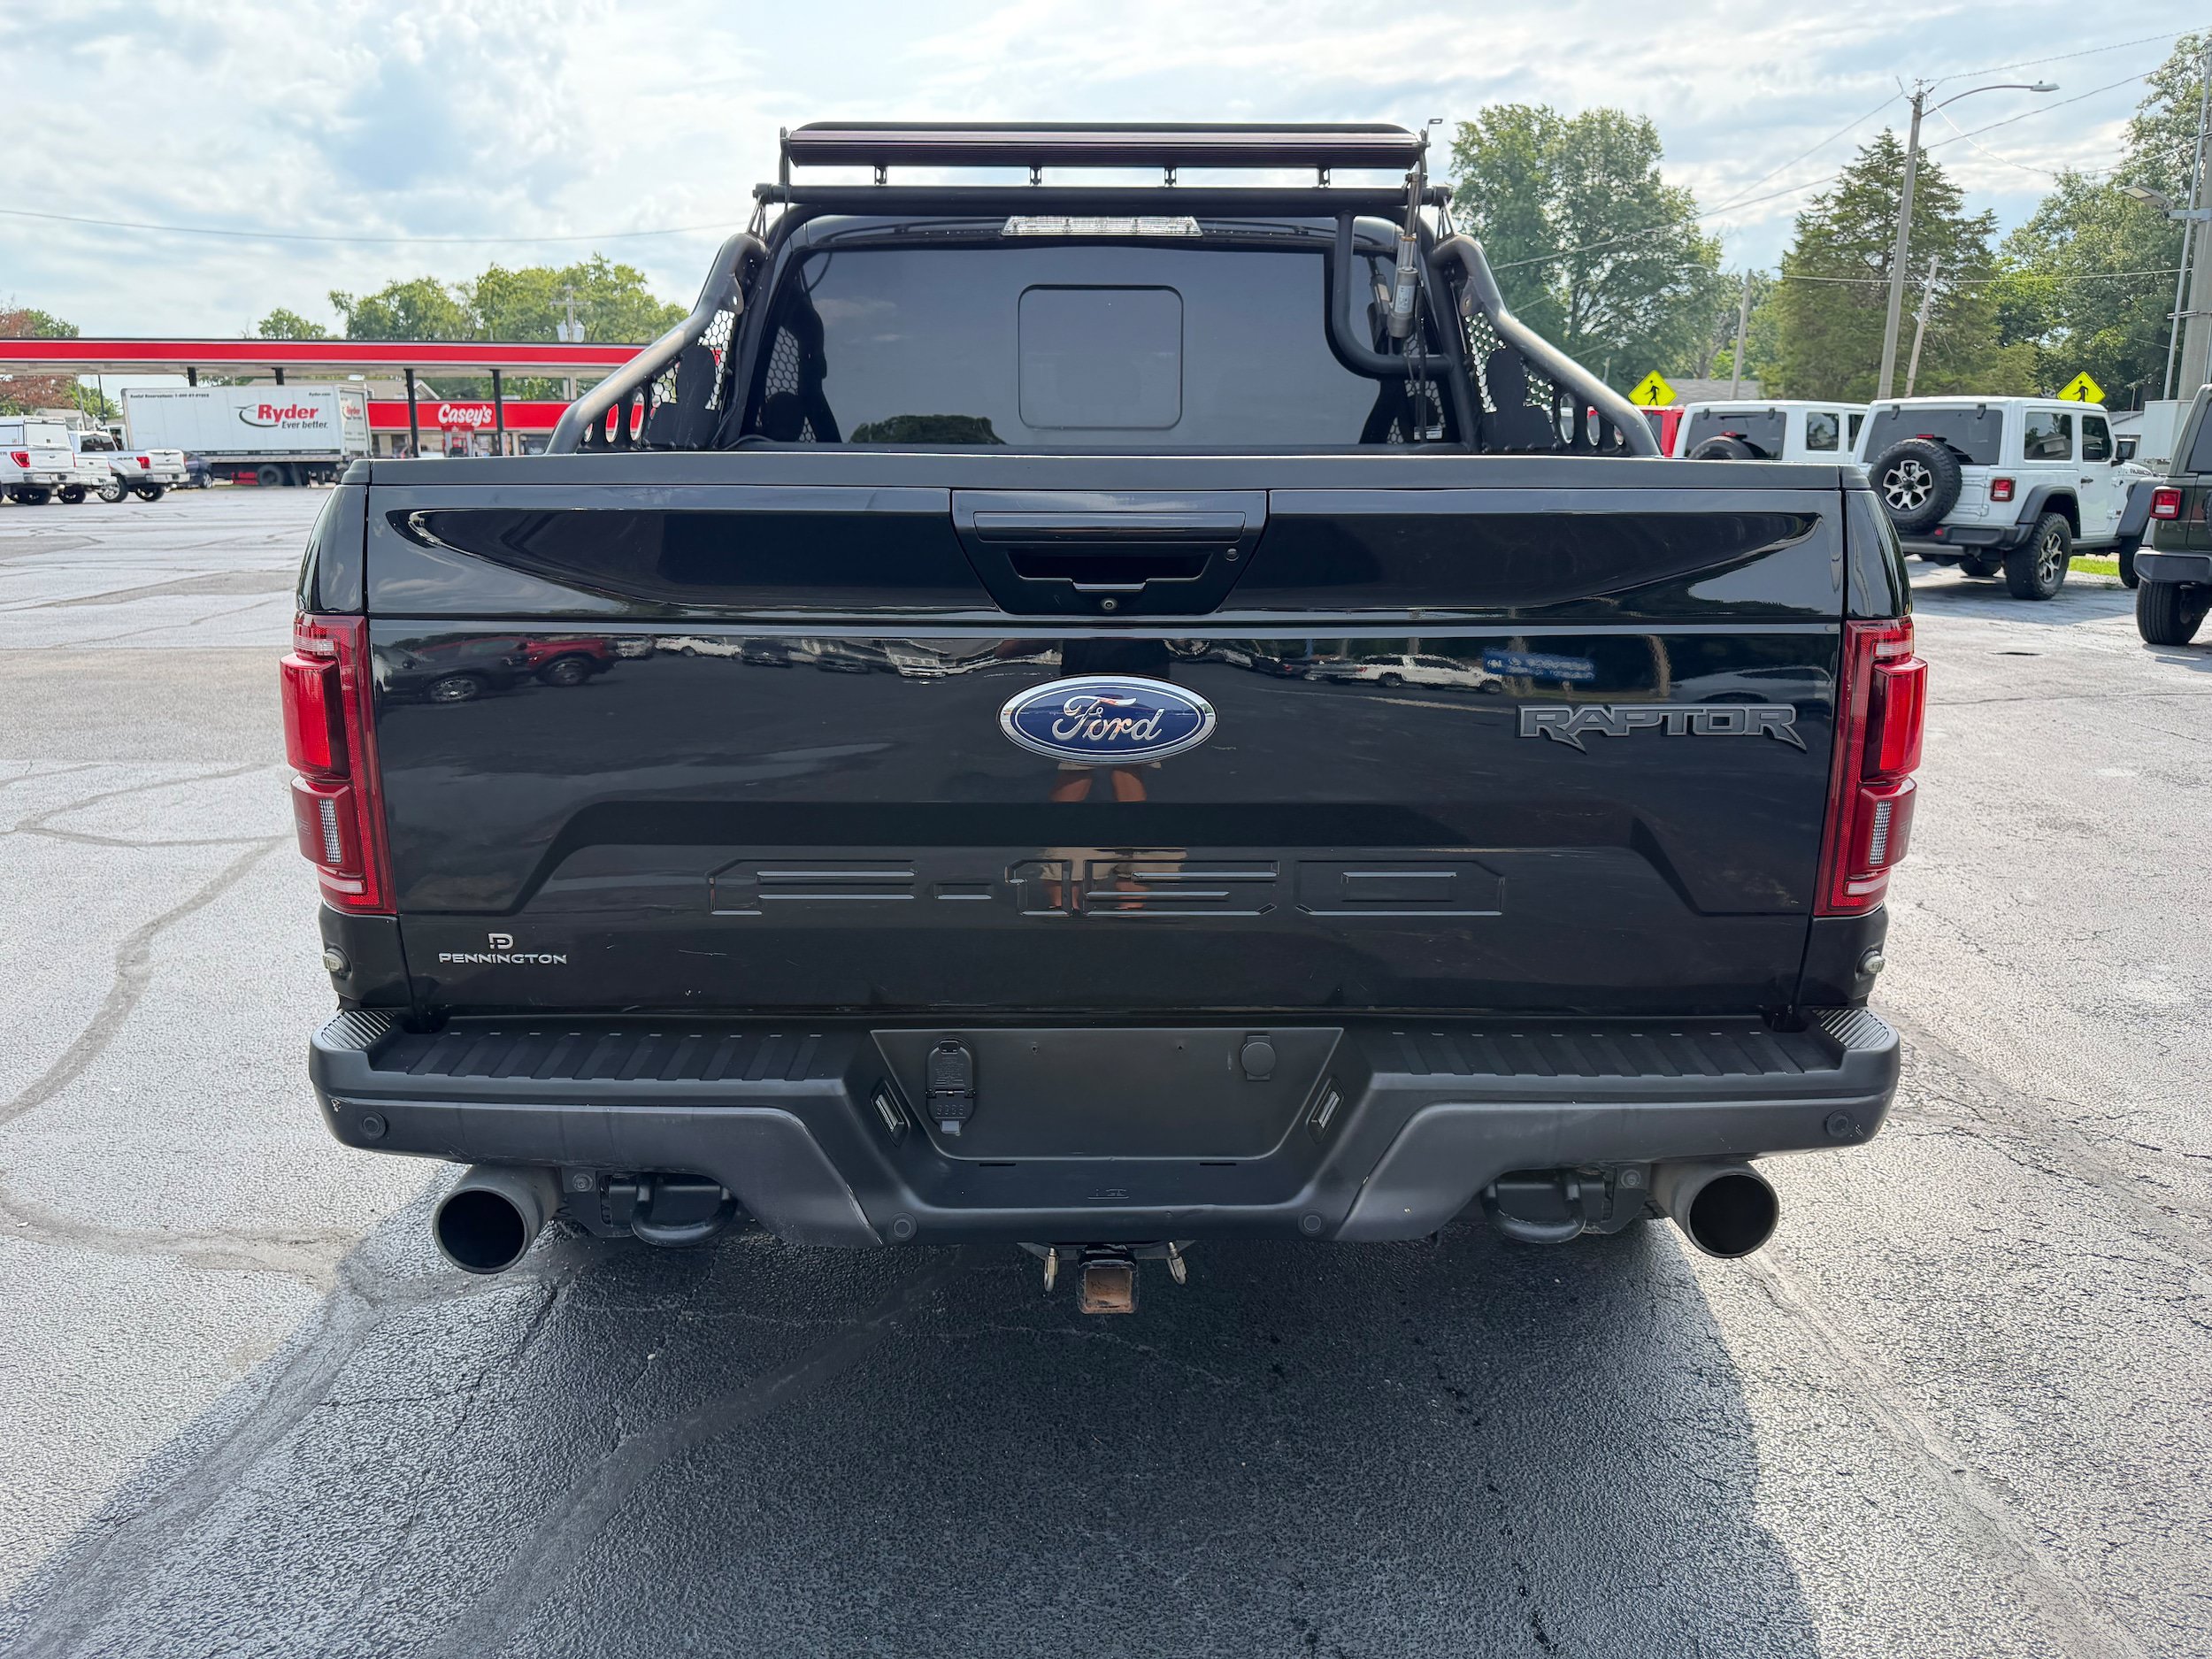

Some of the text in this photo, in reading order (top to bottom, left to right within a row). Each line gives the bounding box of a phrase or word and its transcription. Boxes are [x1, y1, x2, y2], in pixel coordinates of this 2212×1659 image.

[257, 403, 319, 423] Ryder
[438, 403, 493, 427] Casey's
[281, 420, 329, 429] Ever better.
[1051, 695, 1165, 741] Ford
[1516, 704, 1808, 753] RAPTOR
[438, 953, 567, 964] PENNINGTON
